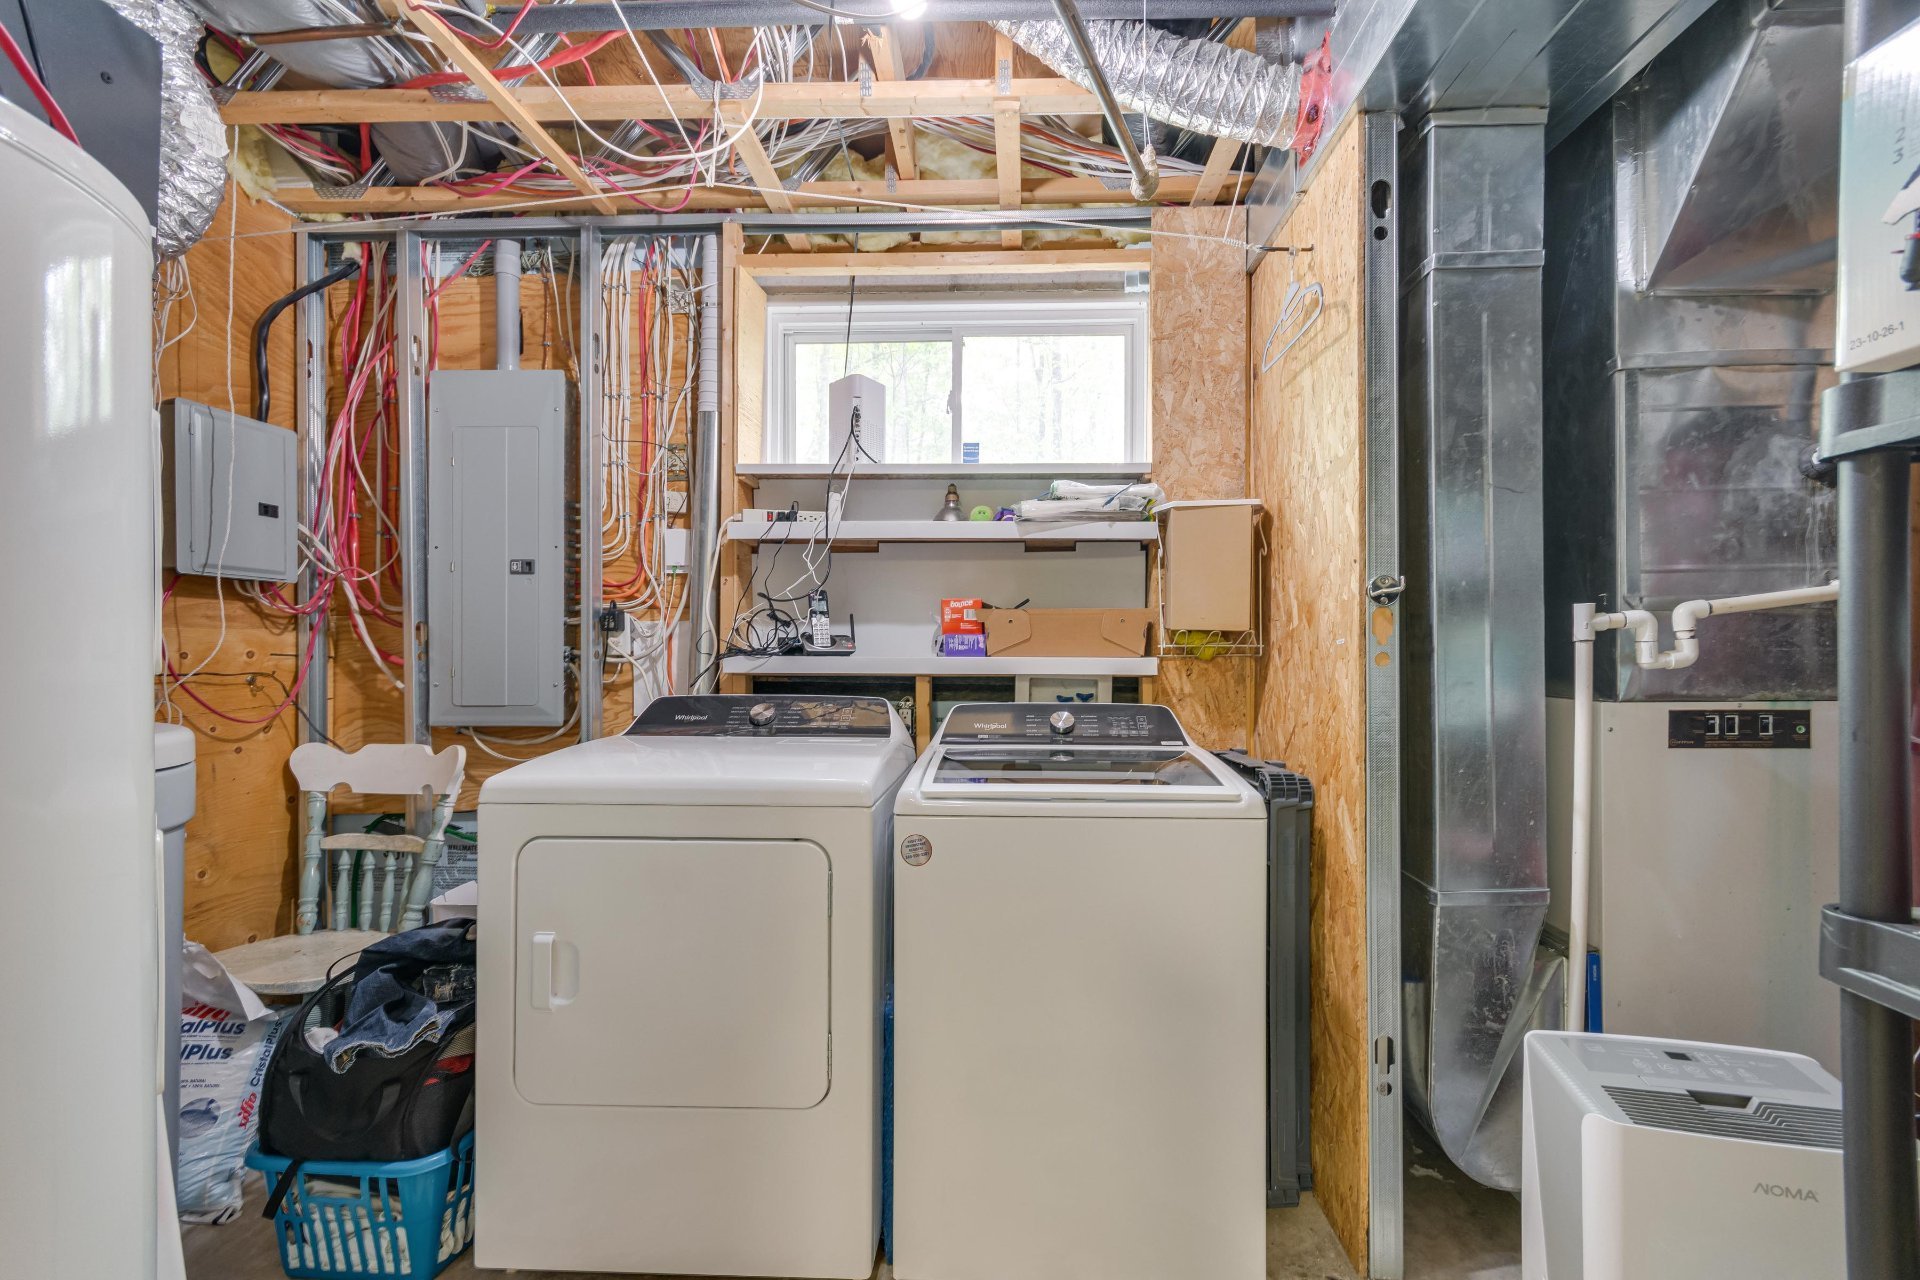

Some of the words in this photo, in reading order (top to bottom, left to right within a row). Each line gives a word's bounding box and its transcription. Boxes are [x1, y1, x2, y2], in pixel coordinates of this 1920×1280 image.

[1849, 320, 1905, 351] 23-10-26-1
[675, 714, 708, 722] Whirlpool
[974, 722, 1007, 730] Whirlpool
[180, 1019, 246, 1035] alPlus
[180, 1043, 234, 1061] lPlus
[1752, 1182, 1820, 1203] NOMA
